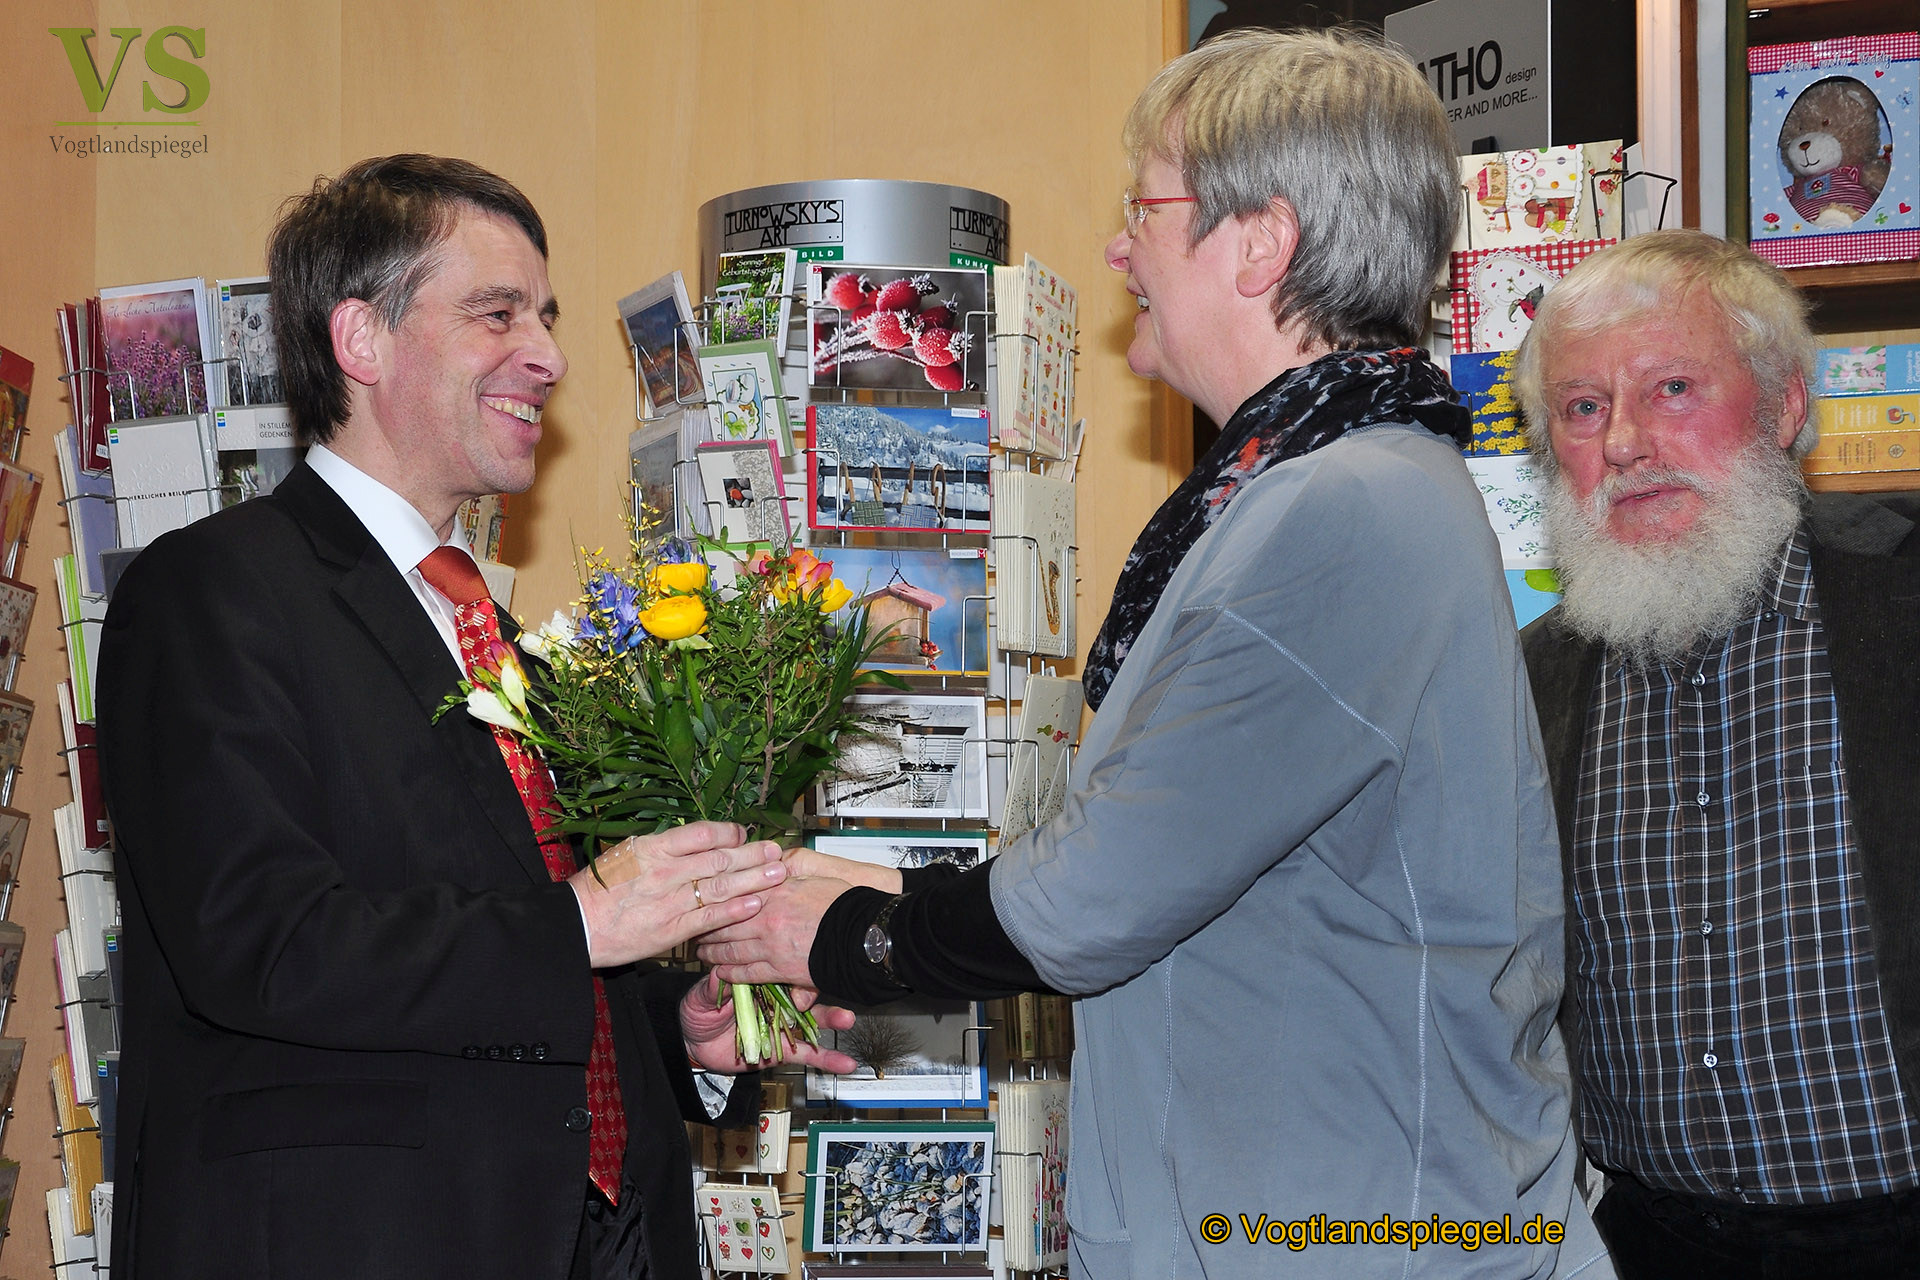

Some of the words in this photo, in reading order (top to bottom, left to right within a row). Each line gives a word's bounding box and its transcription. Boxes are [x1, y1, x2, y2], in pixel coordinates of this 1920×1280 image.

[1505, 66, 1537, 84] design
[1464, 99, 1490, 119] AND
[1492, 88, 1538, 111] MORE...
[760, 223, 791, 249] ART
[801, 250, 835, 259] BILD
[956, 257, 990, 270] KUNS
[267, 422, 292, 430] STILLEM
[259, 431, 293, 439] GEDENKEN
